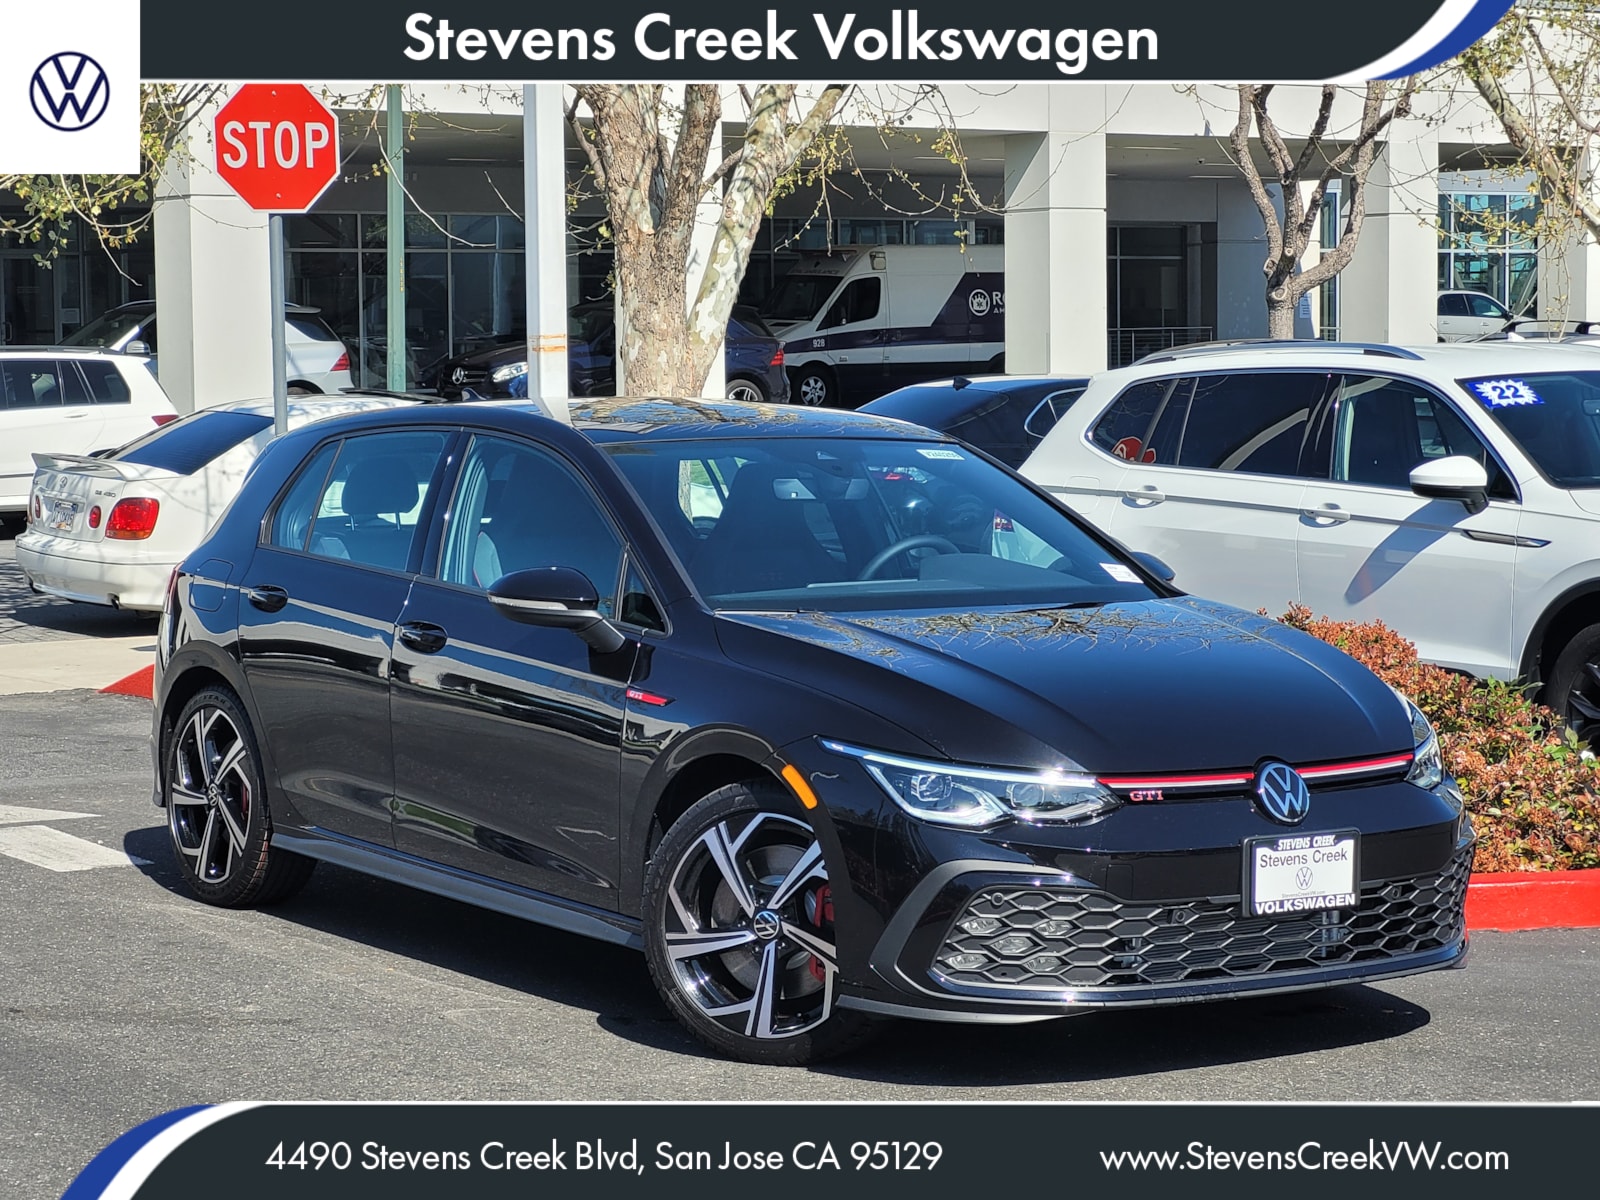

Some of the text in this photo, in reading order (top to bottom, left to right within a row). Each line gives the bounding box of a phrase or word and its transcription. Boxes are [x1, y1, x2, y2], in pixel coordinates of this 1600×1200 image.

[222, 120, 330, 169] STOP
[812, 338, 826, 348] 928
[1491, 384, 1525, 400] 22
[1129, 790, 1164, 801] GTI
[1277, 834, 1336, 851] STEVENS CREEK
[1260, 848, 1348, 868] Stevens Creek
[1255, 893, 1356, 915] VOLKSWAGEN
